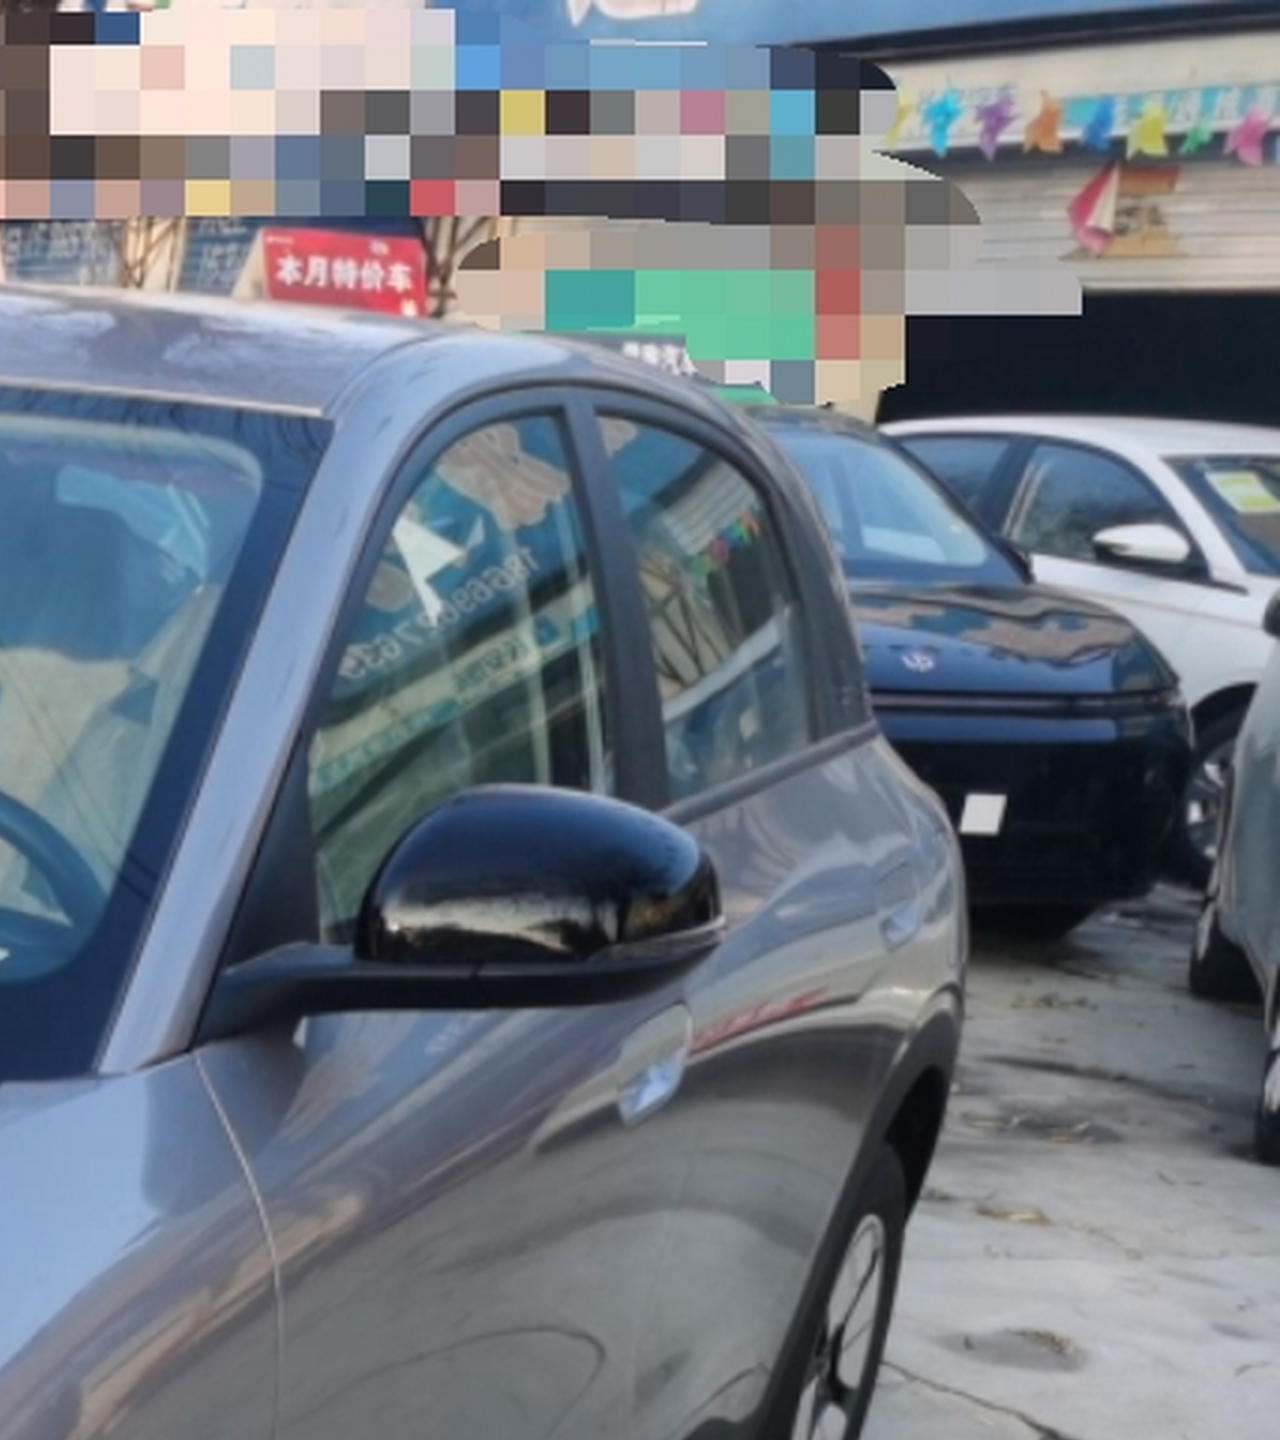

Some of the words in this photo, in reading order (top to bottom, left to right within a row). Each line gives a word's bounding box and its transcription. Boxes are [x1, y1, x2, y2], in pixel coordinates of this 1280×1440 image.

[276, 254, 414, 293] 本月特价车
